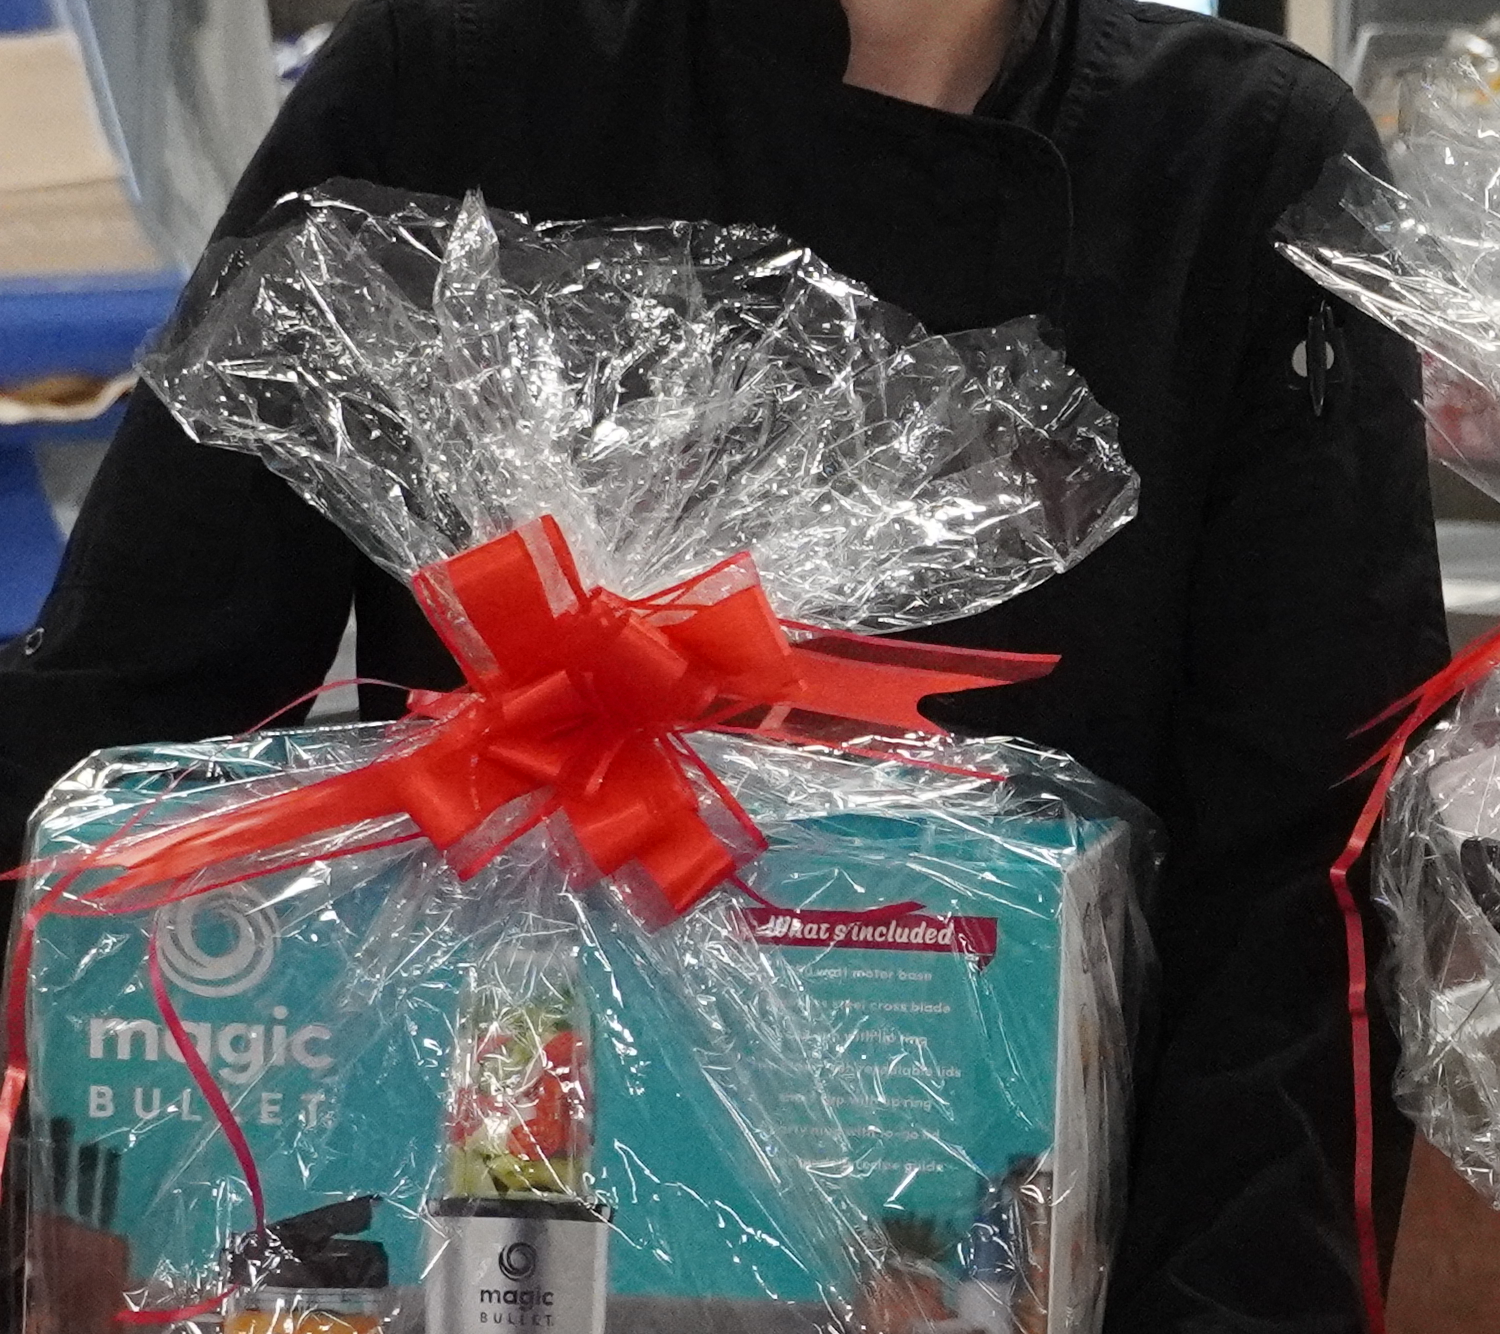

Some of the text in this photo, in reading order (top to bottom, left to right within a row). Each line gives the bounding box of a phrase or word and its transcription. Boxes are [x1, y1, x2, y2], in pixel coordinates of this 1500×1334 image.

[851, 919, 952, 946] included
[88, 1005, 336, 1085] magic
[88, 1084, 327, 1127] BULET
[480, 1289, 555, 1312] magic
[480, 1311, 554, 1327] BULLET
